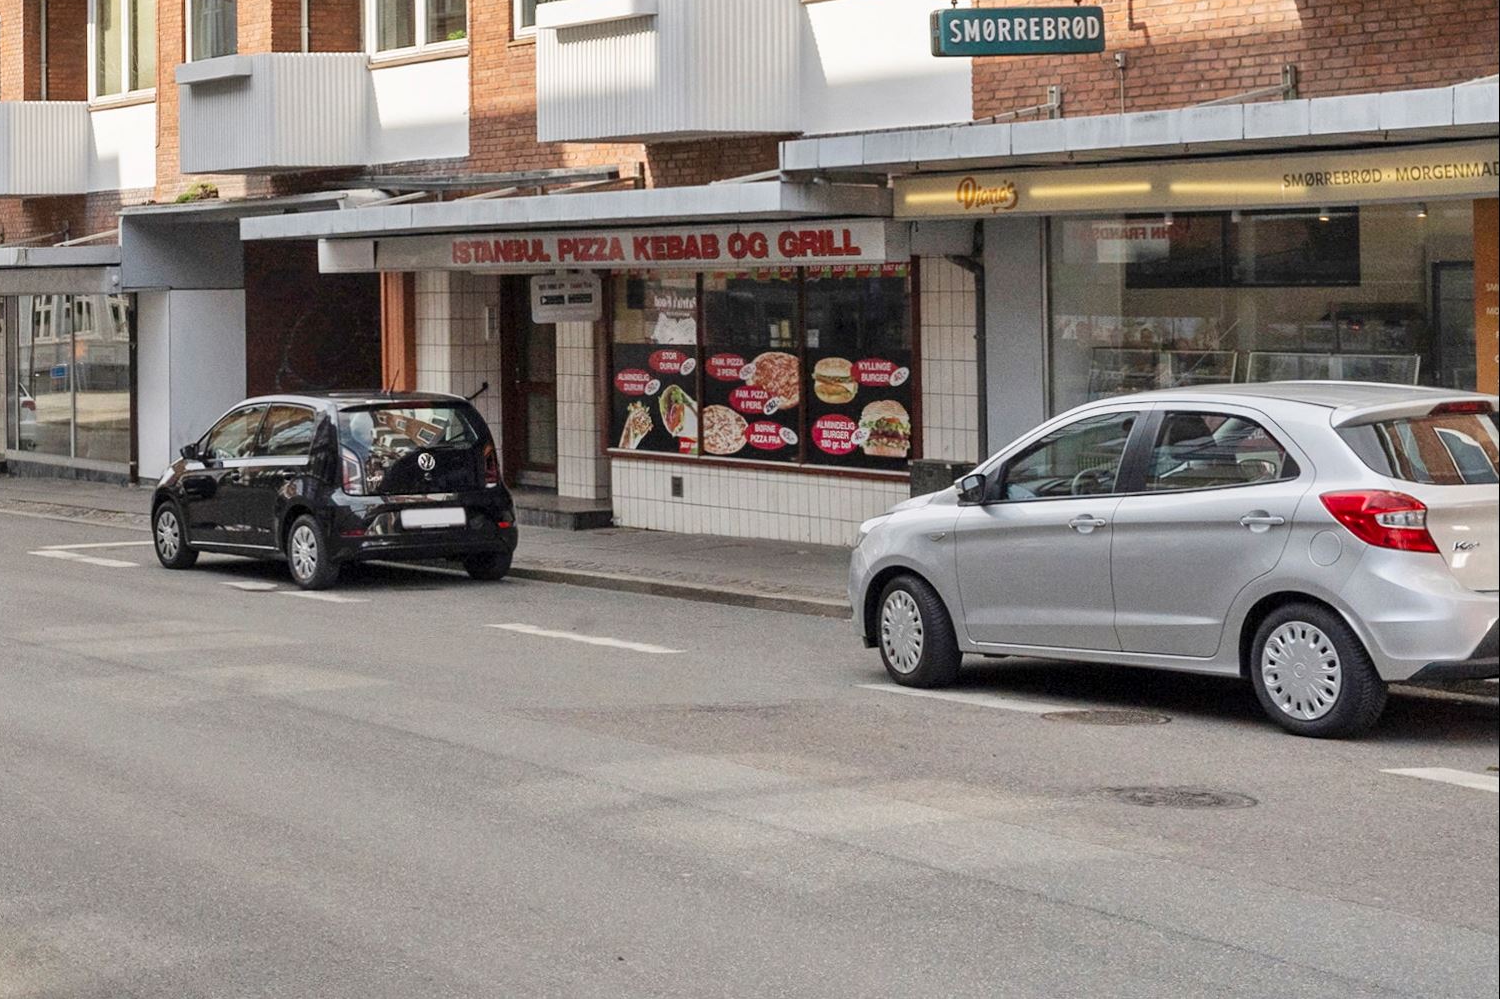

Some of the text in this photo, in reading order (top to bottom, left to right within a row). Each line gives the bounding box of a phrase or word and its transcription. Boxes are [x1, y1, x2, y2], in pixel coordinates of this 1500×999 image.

[950, 16, 1100, 43] SMØRREBRØD
[1283, 168, 1383, 188] SMØRREBRØD
[452, 229, 862, 263] ISTANBUL PIZZA KEBAB OG GRILL
[727, 358, 744, 366] PIZZA
[859, 362, 891, 371] KYLLINGE
[861, 373, 889, 382] BURGER
[735, 390, 750, 398] FAM.
[817, 421, 855, 430] ALMINDELIG
[750, 434, 768, 442] PIZZA
[769, 435, 781, 443] FRA
[822, 430, 849, 439] BURGER
